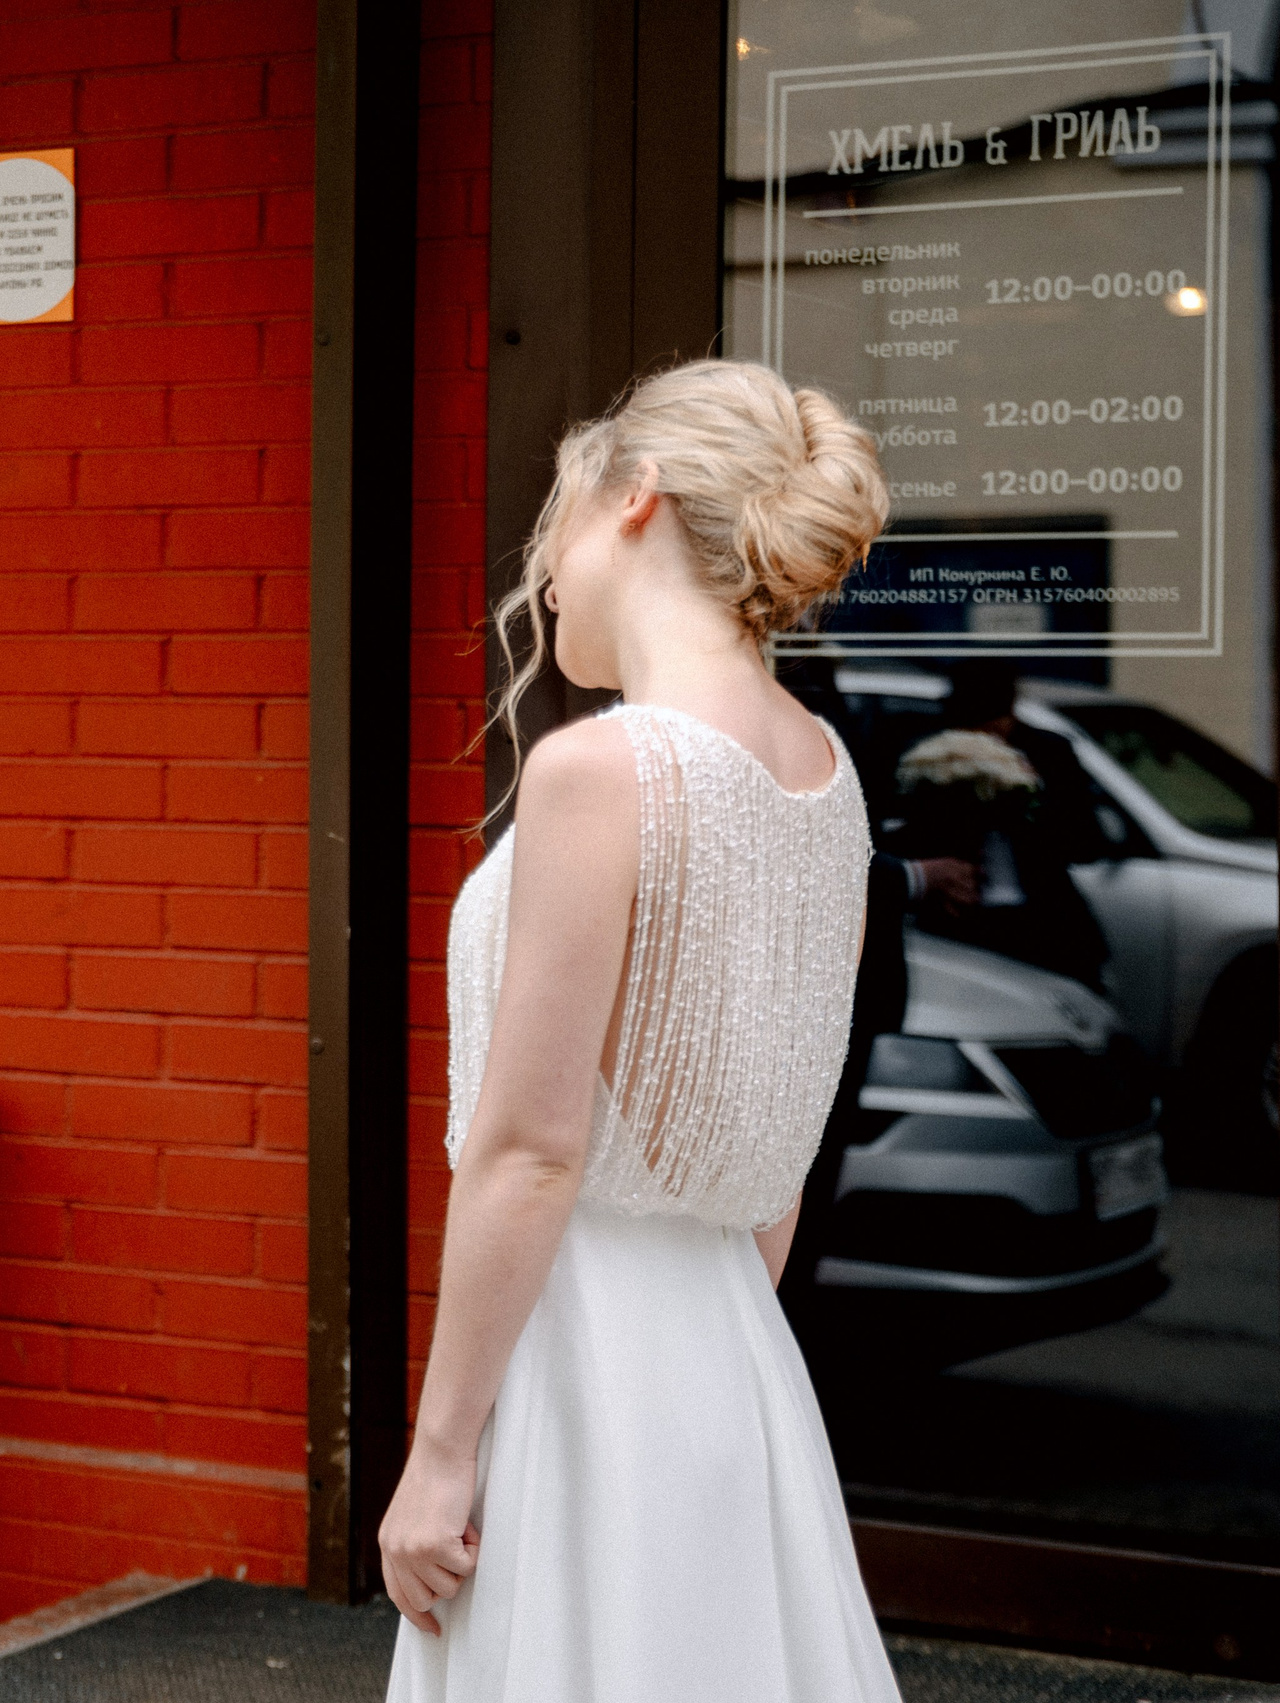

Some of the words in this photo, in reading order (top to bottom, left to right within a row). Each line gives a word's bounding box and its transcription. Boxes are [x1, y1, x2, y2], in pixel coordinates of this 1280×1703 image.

[827, 121, 965, 176] ХМЕЛЬ
[985, 126, 1008, 165] &
[1029, 106, 1161, 161] ГРИЛЬ
[804, 242, 961, 266] понедельник
[861, 275, 960, 298] вторник
[888, 307, 959, 330] среда
[864, 339, 960, 361] четверг
[859, 396, 958, 415] пятница
[875, 425, 958, 452] уббота
[909, 567, 935, 582] ИП
[938, 568, 1026, 585] Конуркина
[850, 589, 968, 605] 760204882157
[972, 588, 1019, 604] ОГРН
